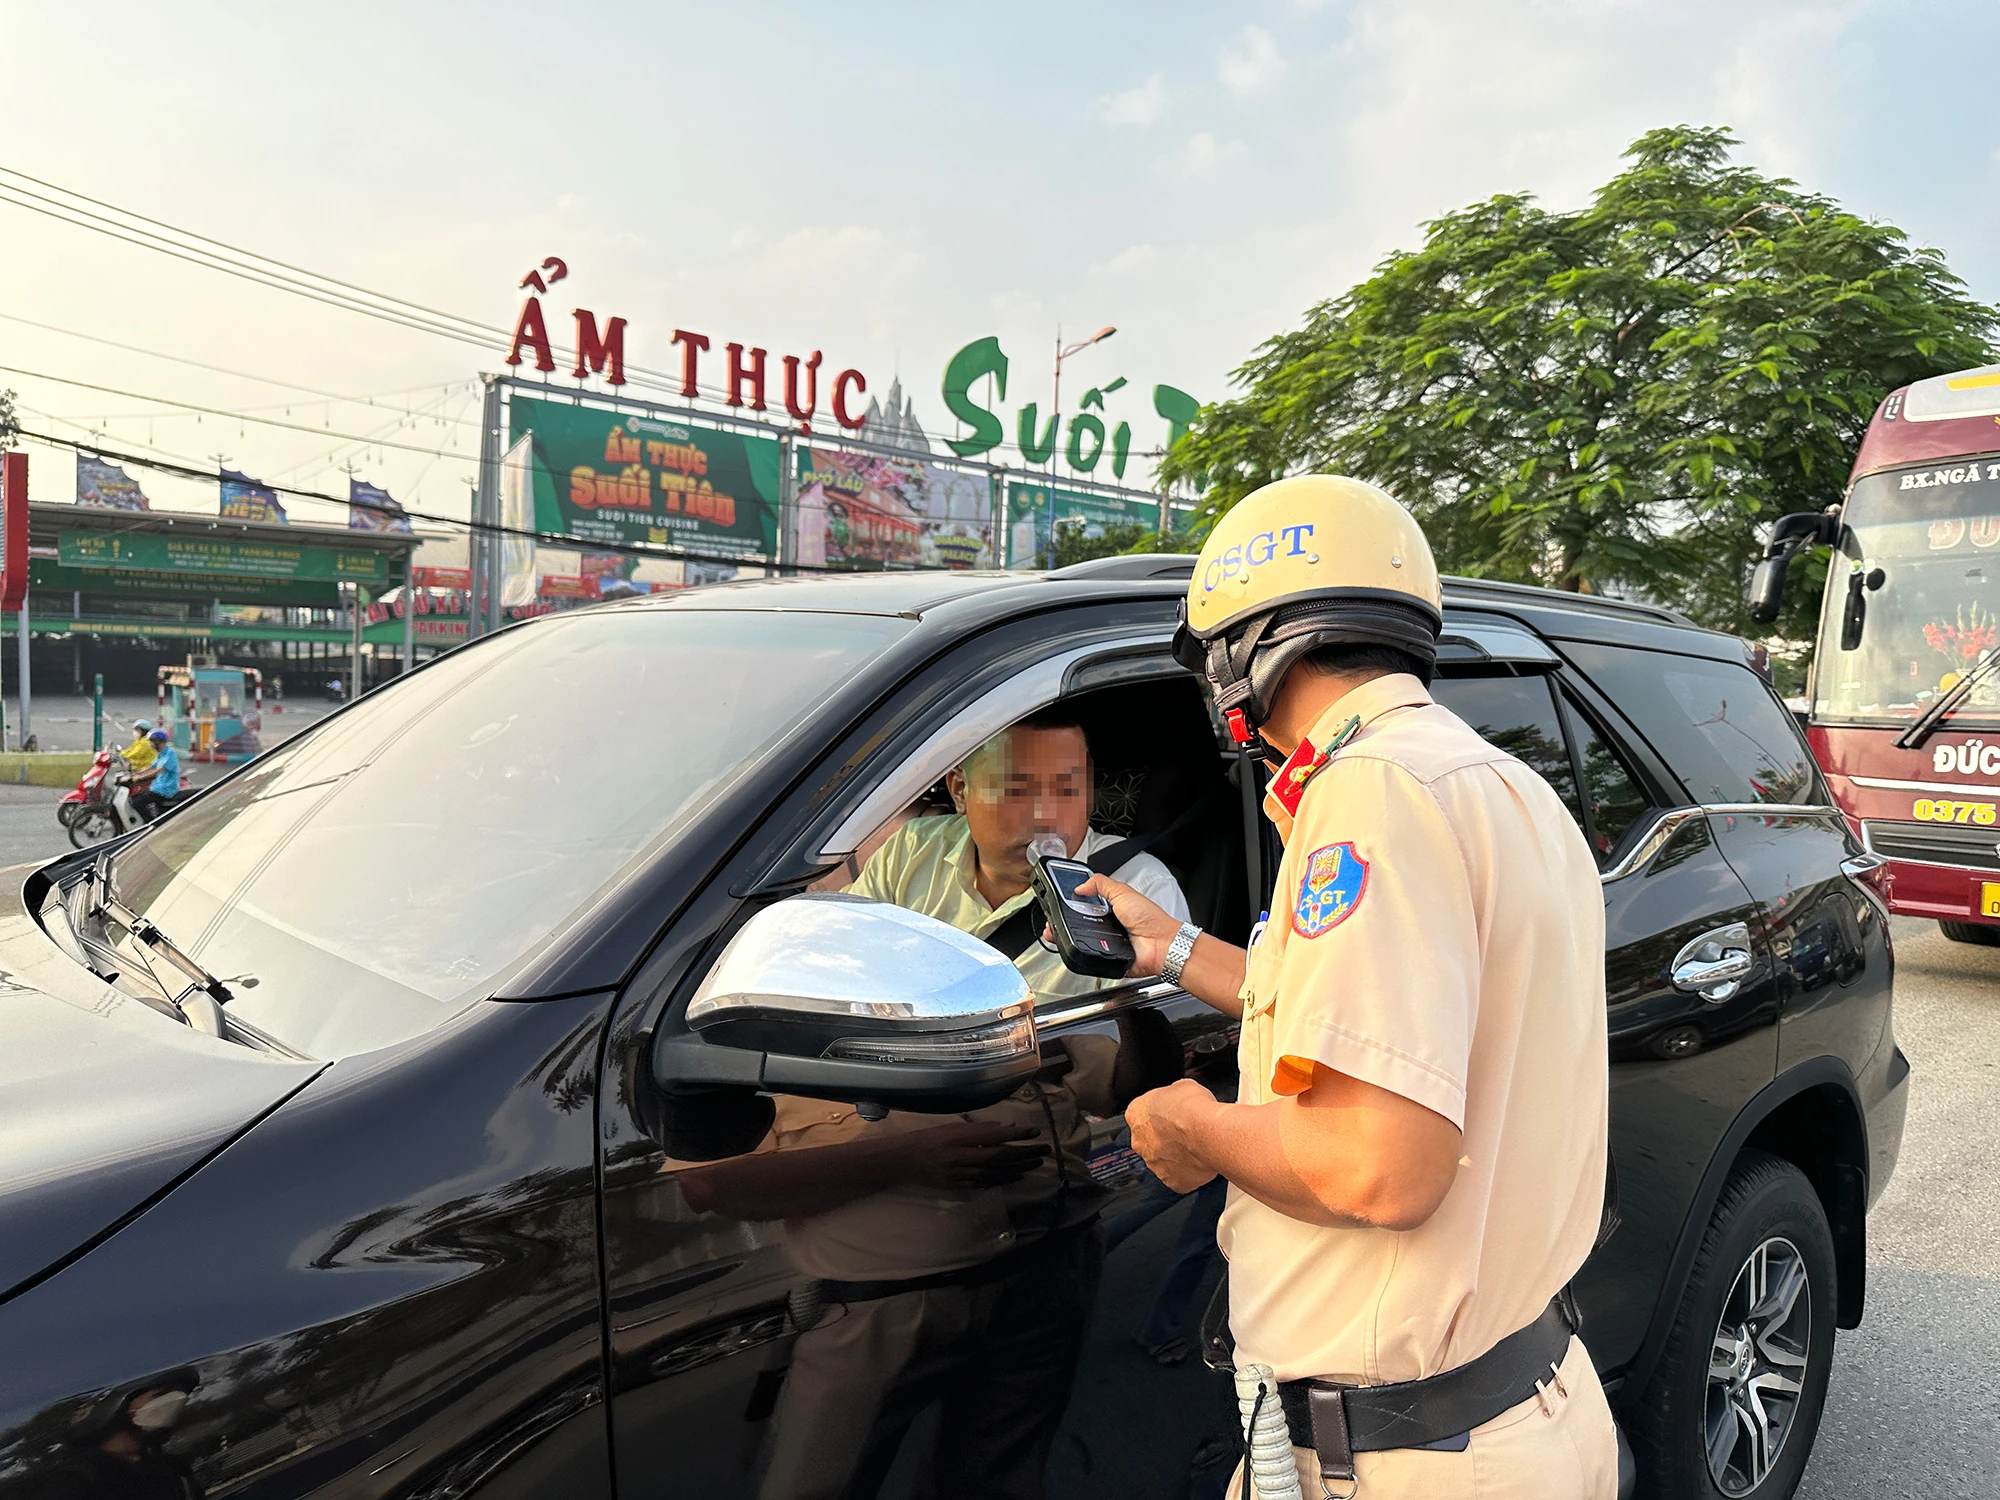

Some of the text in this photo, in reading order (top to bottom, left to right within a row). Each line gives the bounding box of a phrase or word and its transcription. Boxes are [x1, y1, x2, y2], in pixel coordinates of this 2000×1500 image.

[505, 256, 867, 437] ẨM THỰC
[605, 425, 642, 463] ẨM
[646, 440, 708, 477] THỰC
[570, 463, 737, 527] Suối Tiên
[1899, 463, 1982, 490] BX.NGÃ
[628, 513, 653, 526] TIEN
[655, 515, 700, 531] CUISINE
[1204, 524, 1314, 593] CSGT
[1932, 739, 2000, 776] ĐỨC
[1912, 798, 1997, 826] 0375
